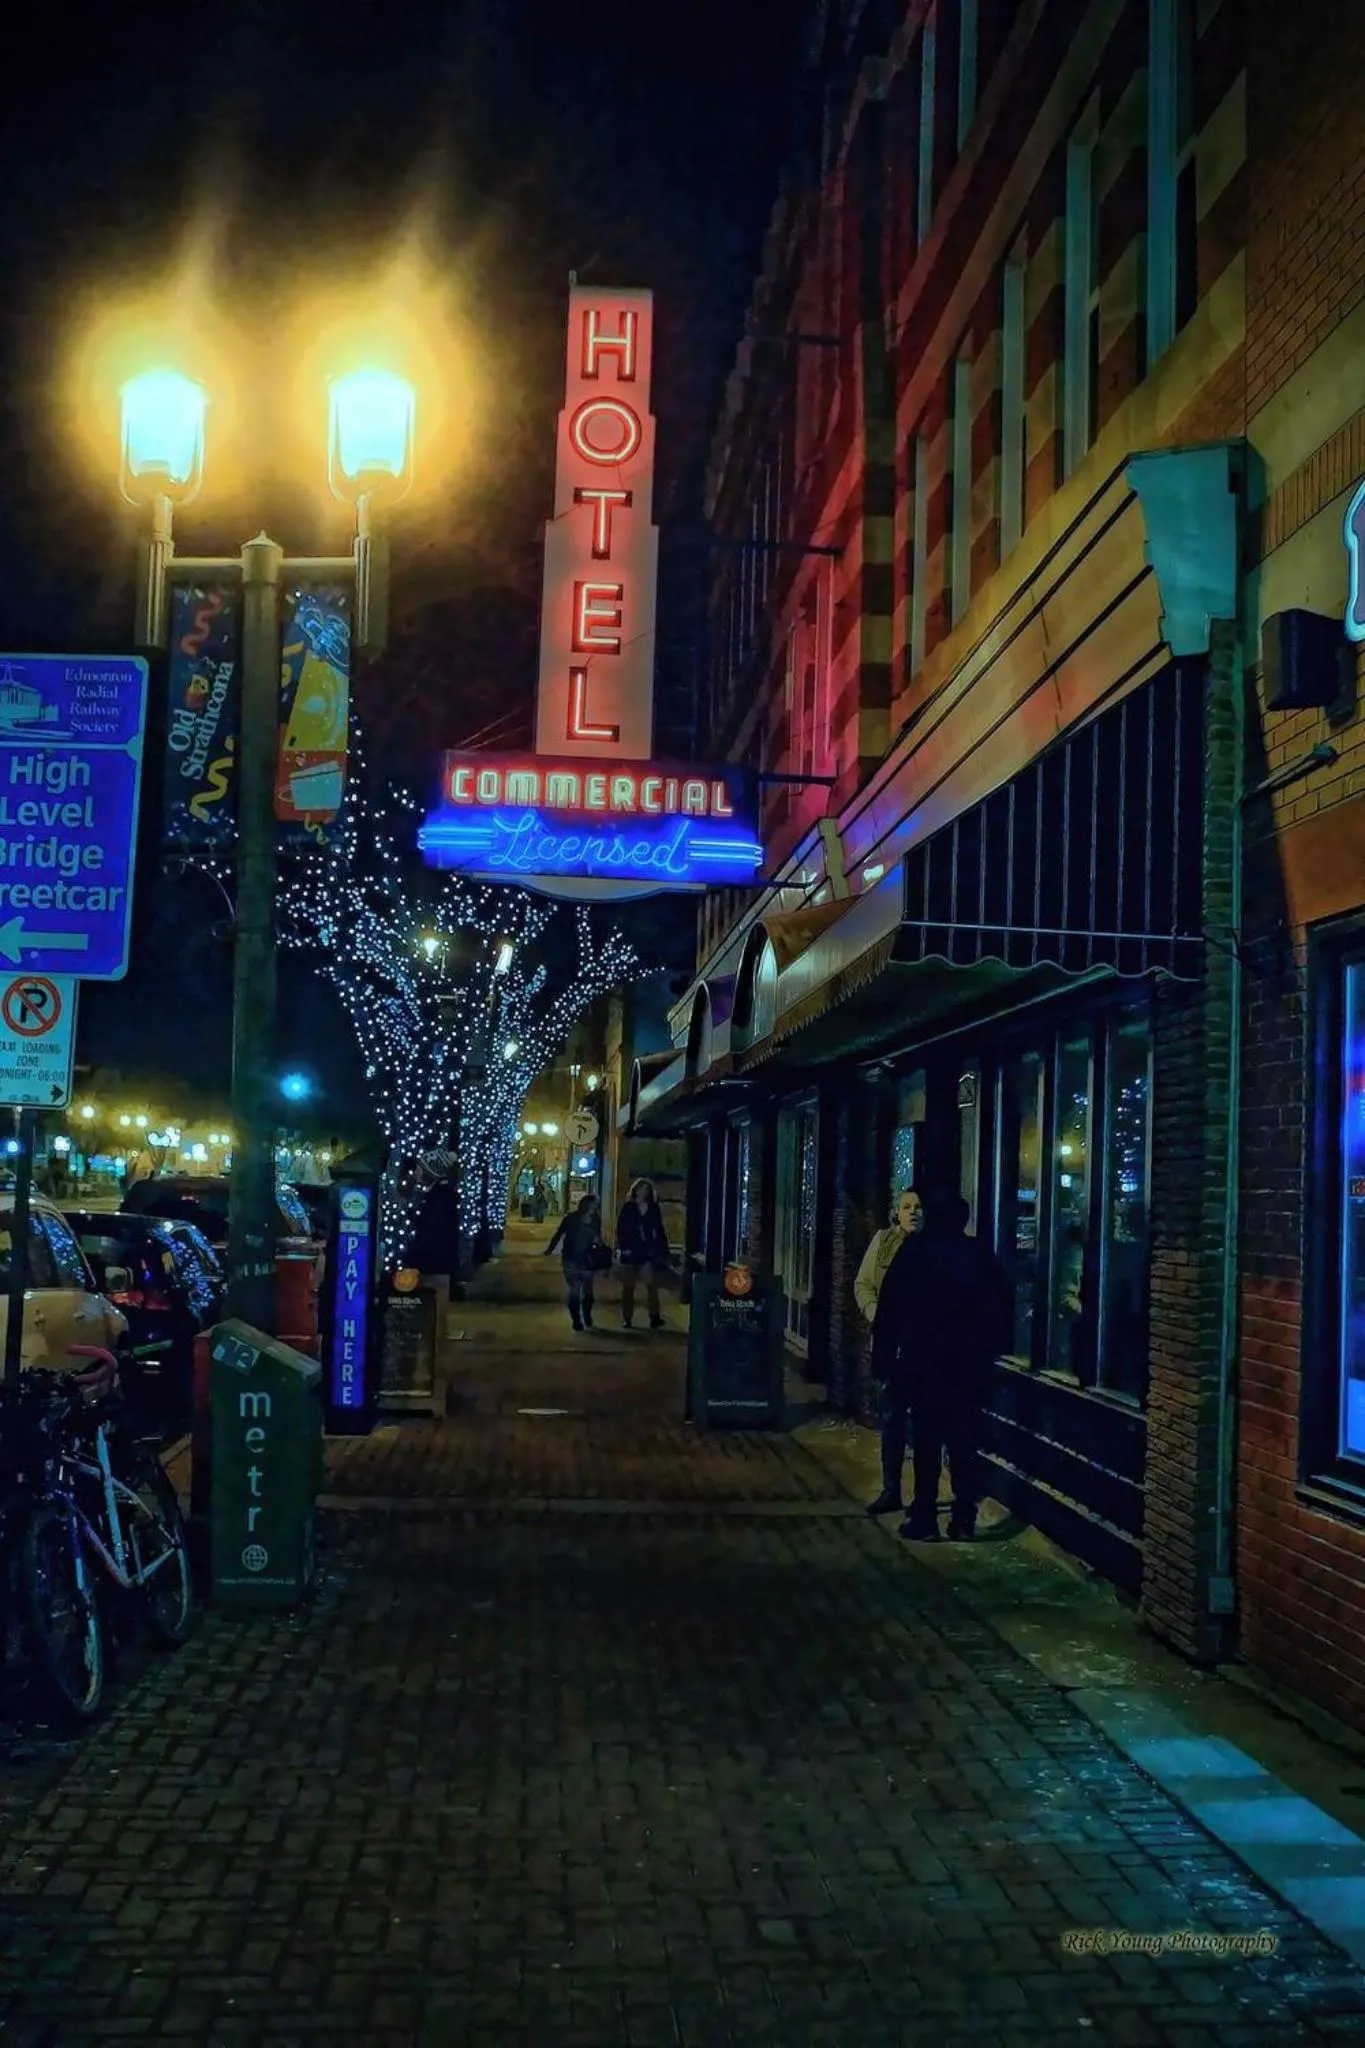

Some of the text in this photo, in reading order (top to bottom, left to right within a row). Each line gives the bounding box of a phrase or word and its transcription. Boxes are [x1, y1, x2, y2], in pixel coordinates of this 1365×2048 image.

[566, 309, 642, 743] HOTEL
[65, 666, 133, 682] Edmonton
[76, 684, 119, 699] Radial
[69, 718, 120, 734] Society
[70, 701, 121, 719] Railway
[180, 661, 235, 780] Strathcona
[168, 708, 197, 752] Old
[10, 753, 91, 794] High
[451, 767, 733, 818] COMMERCIAL
[0, 796, 95, 828] Level
[488, 812, 689, 874] Licensed
[16, 1055, 39, 1068] ZONE
[22, 1042, 62, 1055] LOADING
[342, 1236, 359, 1405] PAY HERE
